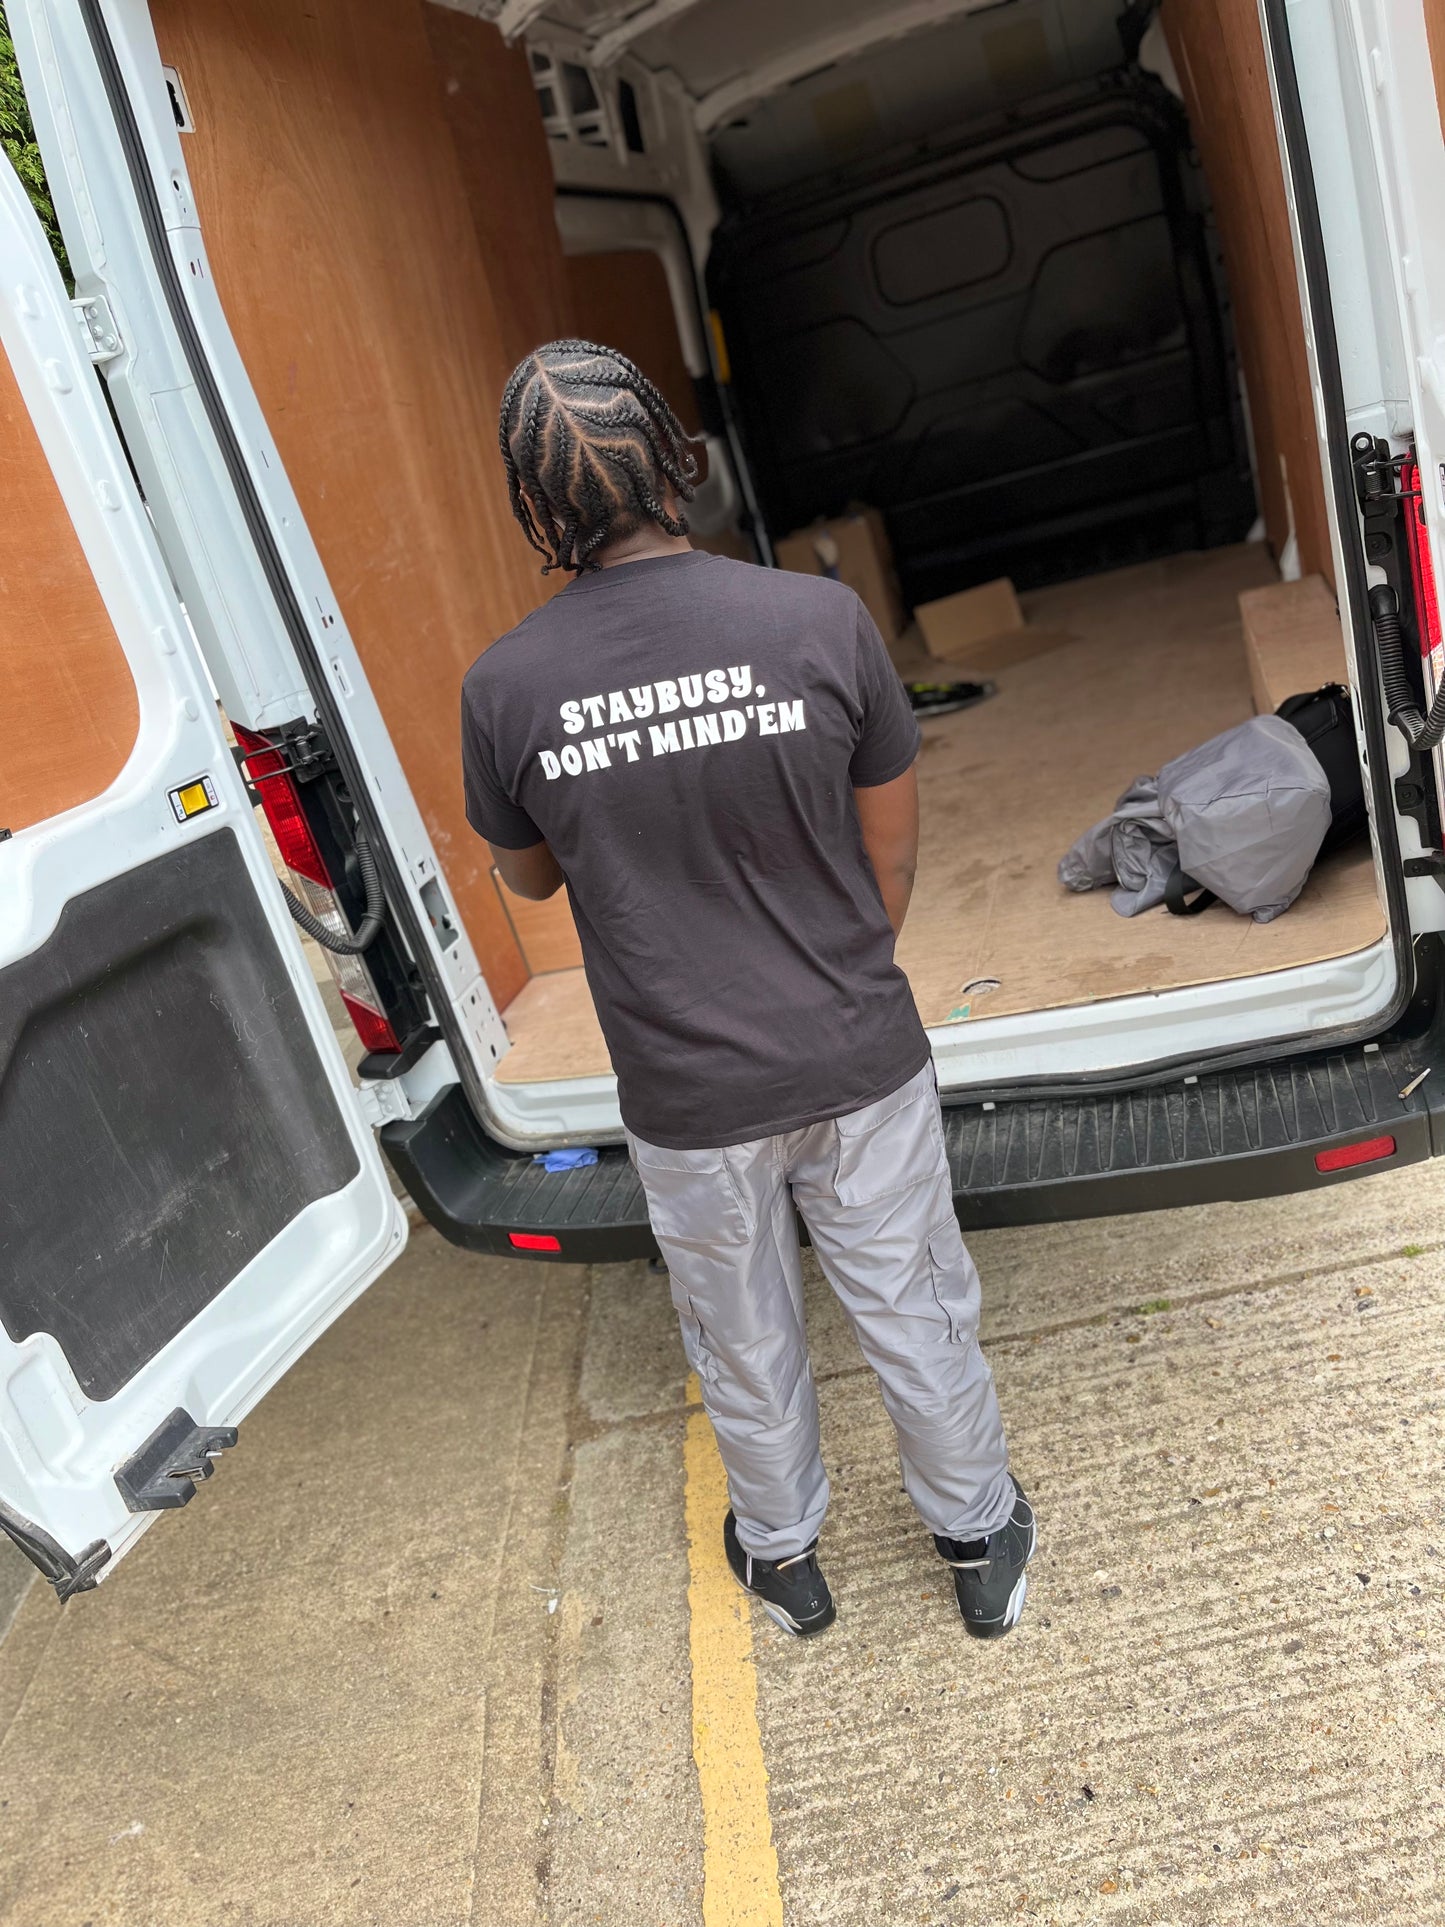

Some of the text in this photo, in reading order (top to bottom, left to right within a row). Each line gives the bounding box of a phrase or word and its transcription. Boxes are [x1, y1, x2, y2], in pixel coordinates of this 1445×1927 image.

[559, 664, 766, 735] STAYBUSY,
[538, 699, 807, 780] DON'T MIND'EM
